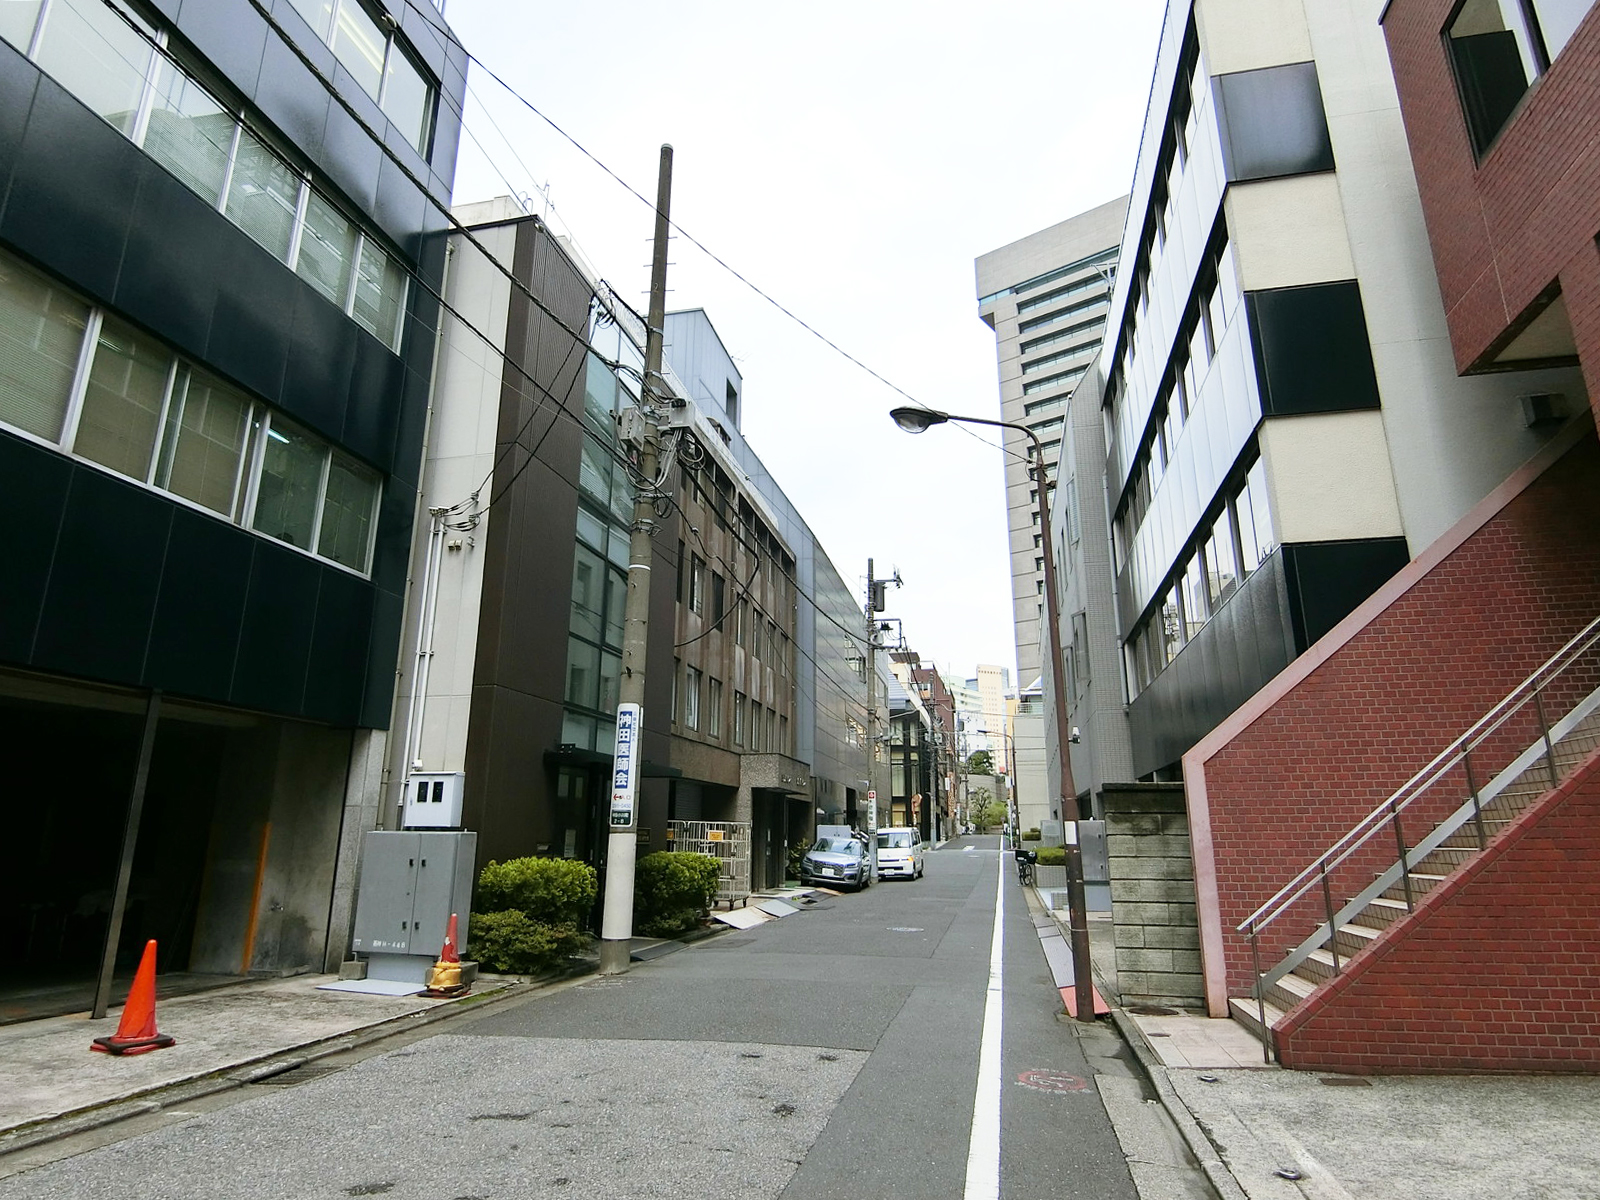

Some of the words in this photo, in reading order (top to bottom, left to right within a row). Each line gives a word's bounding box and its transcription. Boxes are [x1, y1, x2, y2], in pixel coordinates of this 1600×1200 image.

[615, 713, 632, 787] 神田医師会
